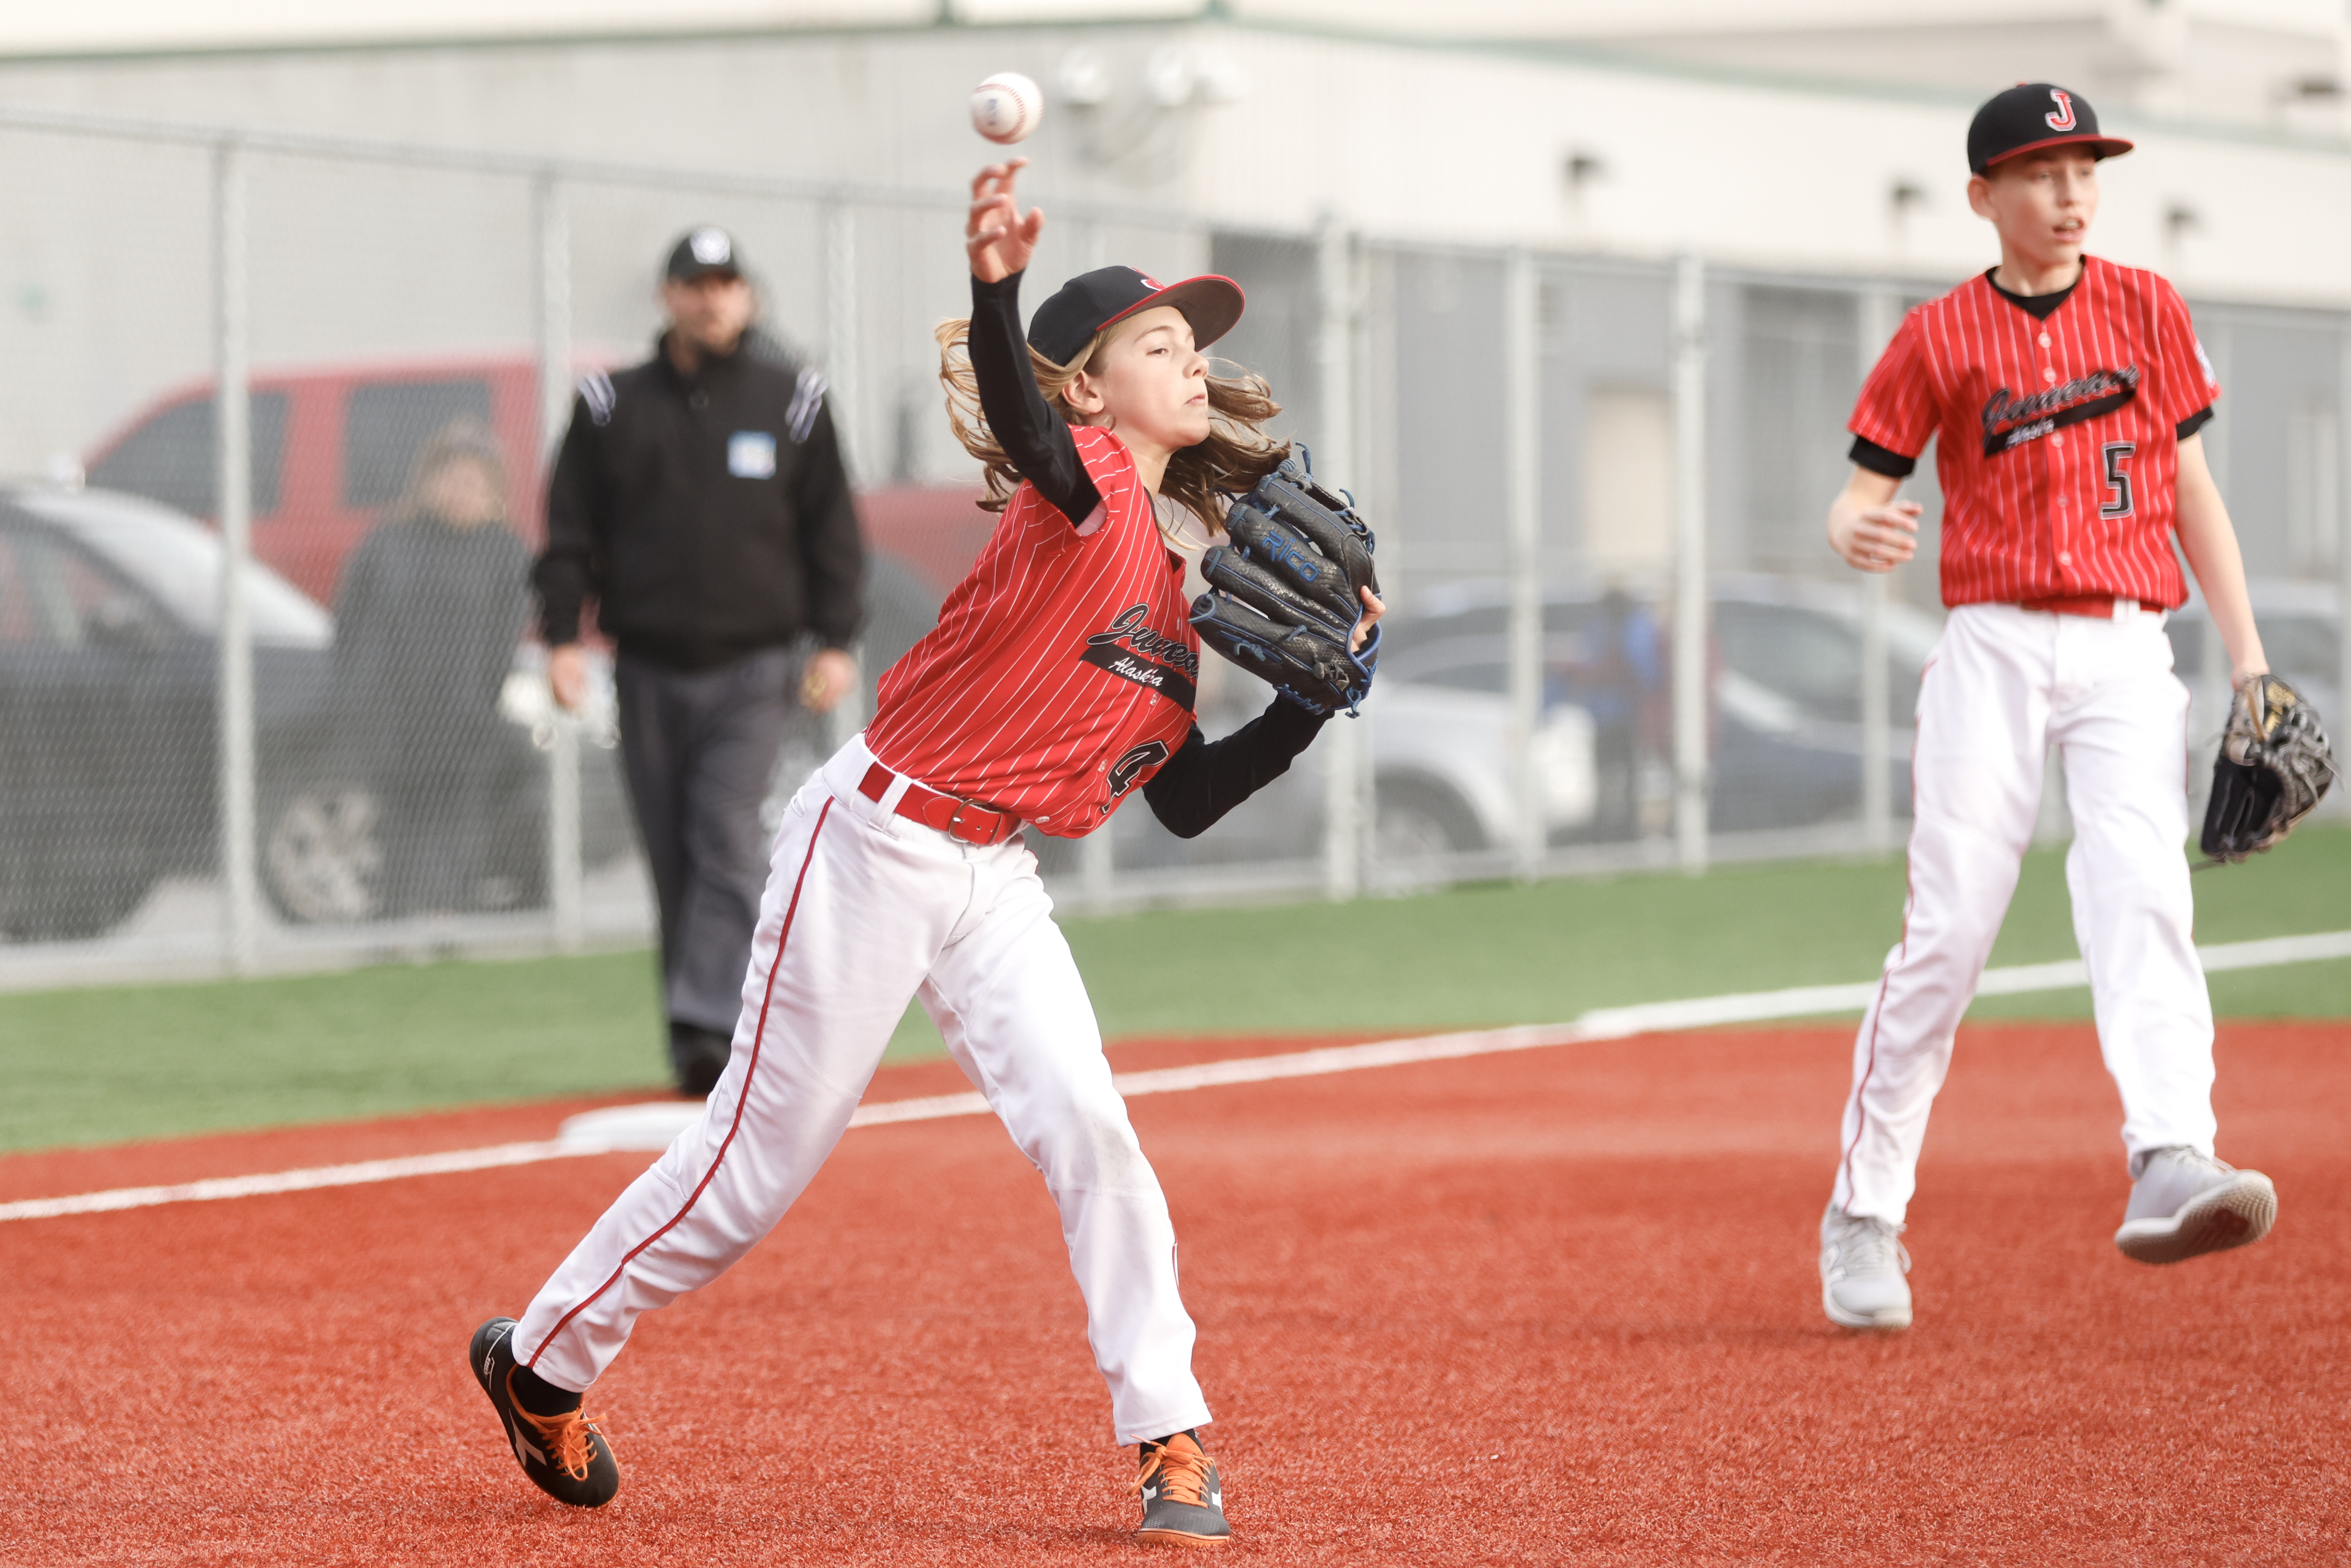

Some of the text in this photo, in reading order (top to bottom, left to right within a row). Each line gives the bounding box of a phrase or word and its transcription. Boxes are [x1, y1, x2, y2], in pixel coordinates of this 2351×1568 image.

[2045, 89, 2077, 131] J
[2099, 441, 2136, 520] 5
[1086, 602, 1199, 678] Junea
[1108, 657, 1164, 687] Alaska
[1102, 739, 1169, 814] 4
